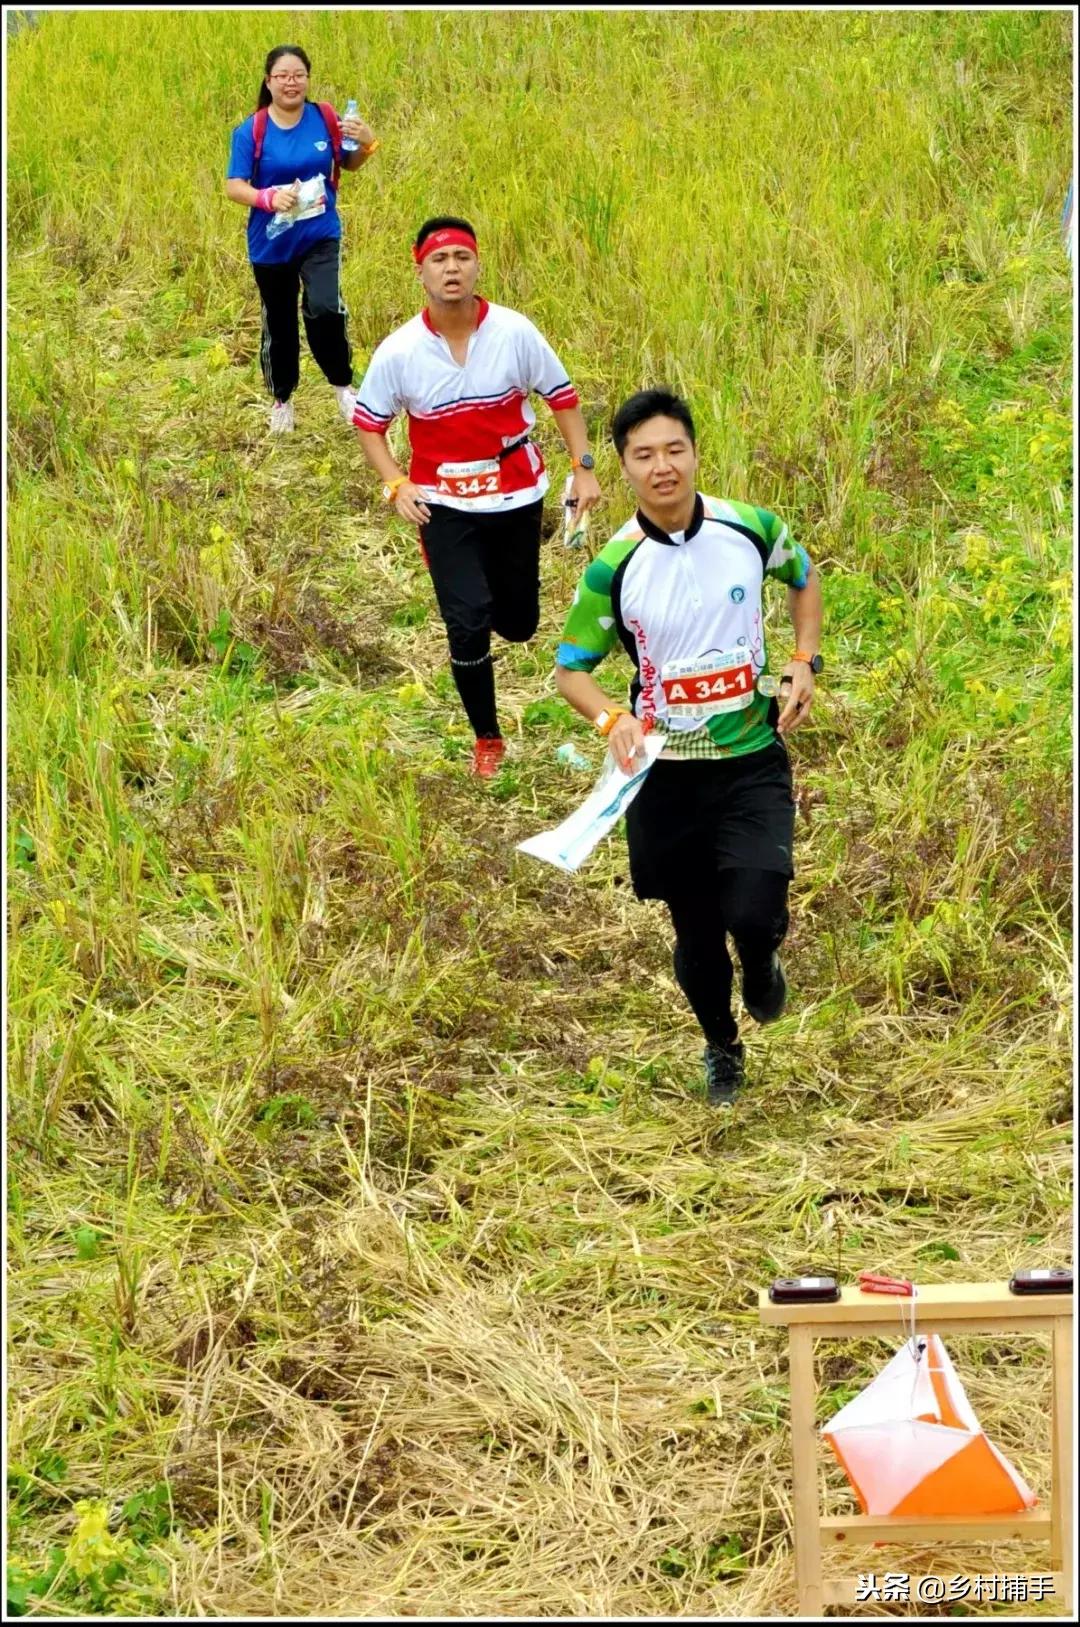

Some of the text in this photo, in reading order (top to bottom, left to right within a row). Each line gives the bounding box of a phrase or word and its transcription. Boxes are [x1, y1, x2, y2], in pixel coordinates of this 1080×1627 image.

[439, 477, 498, 495] A 34-2
[670, 672, 747, 700] A 34-1
